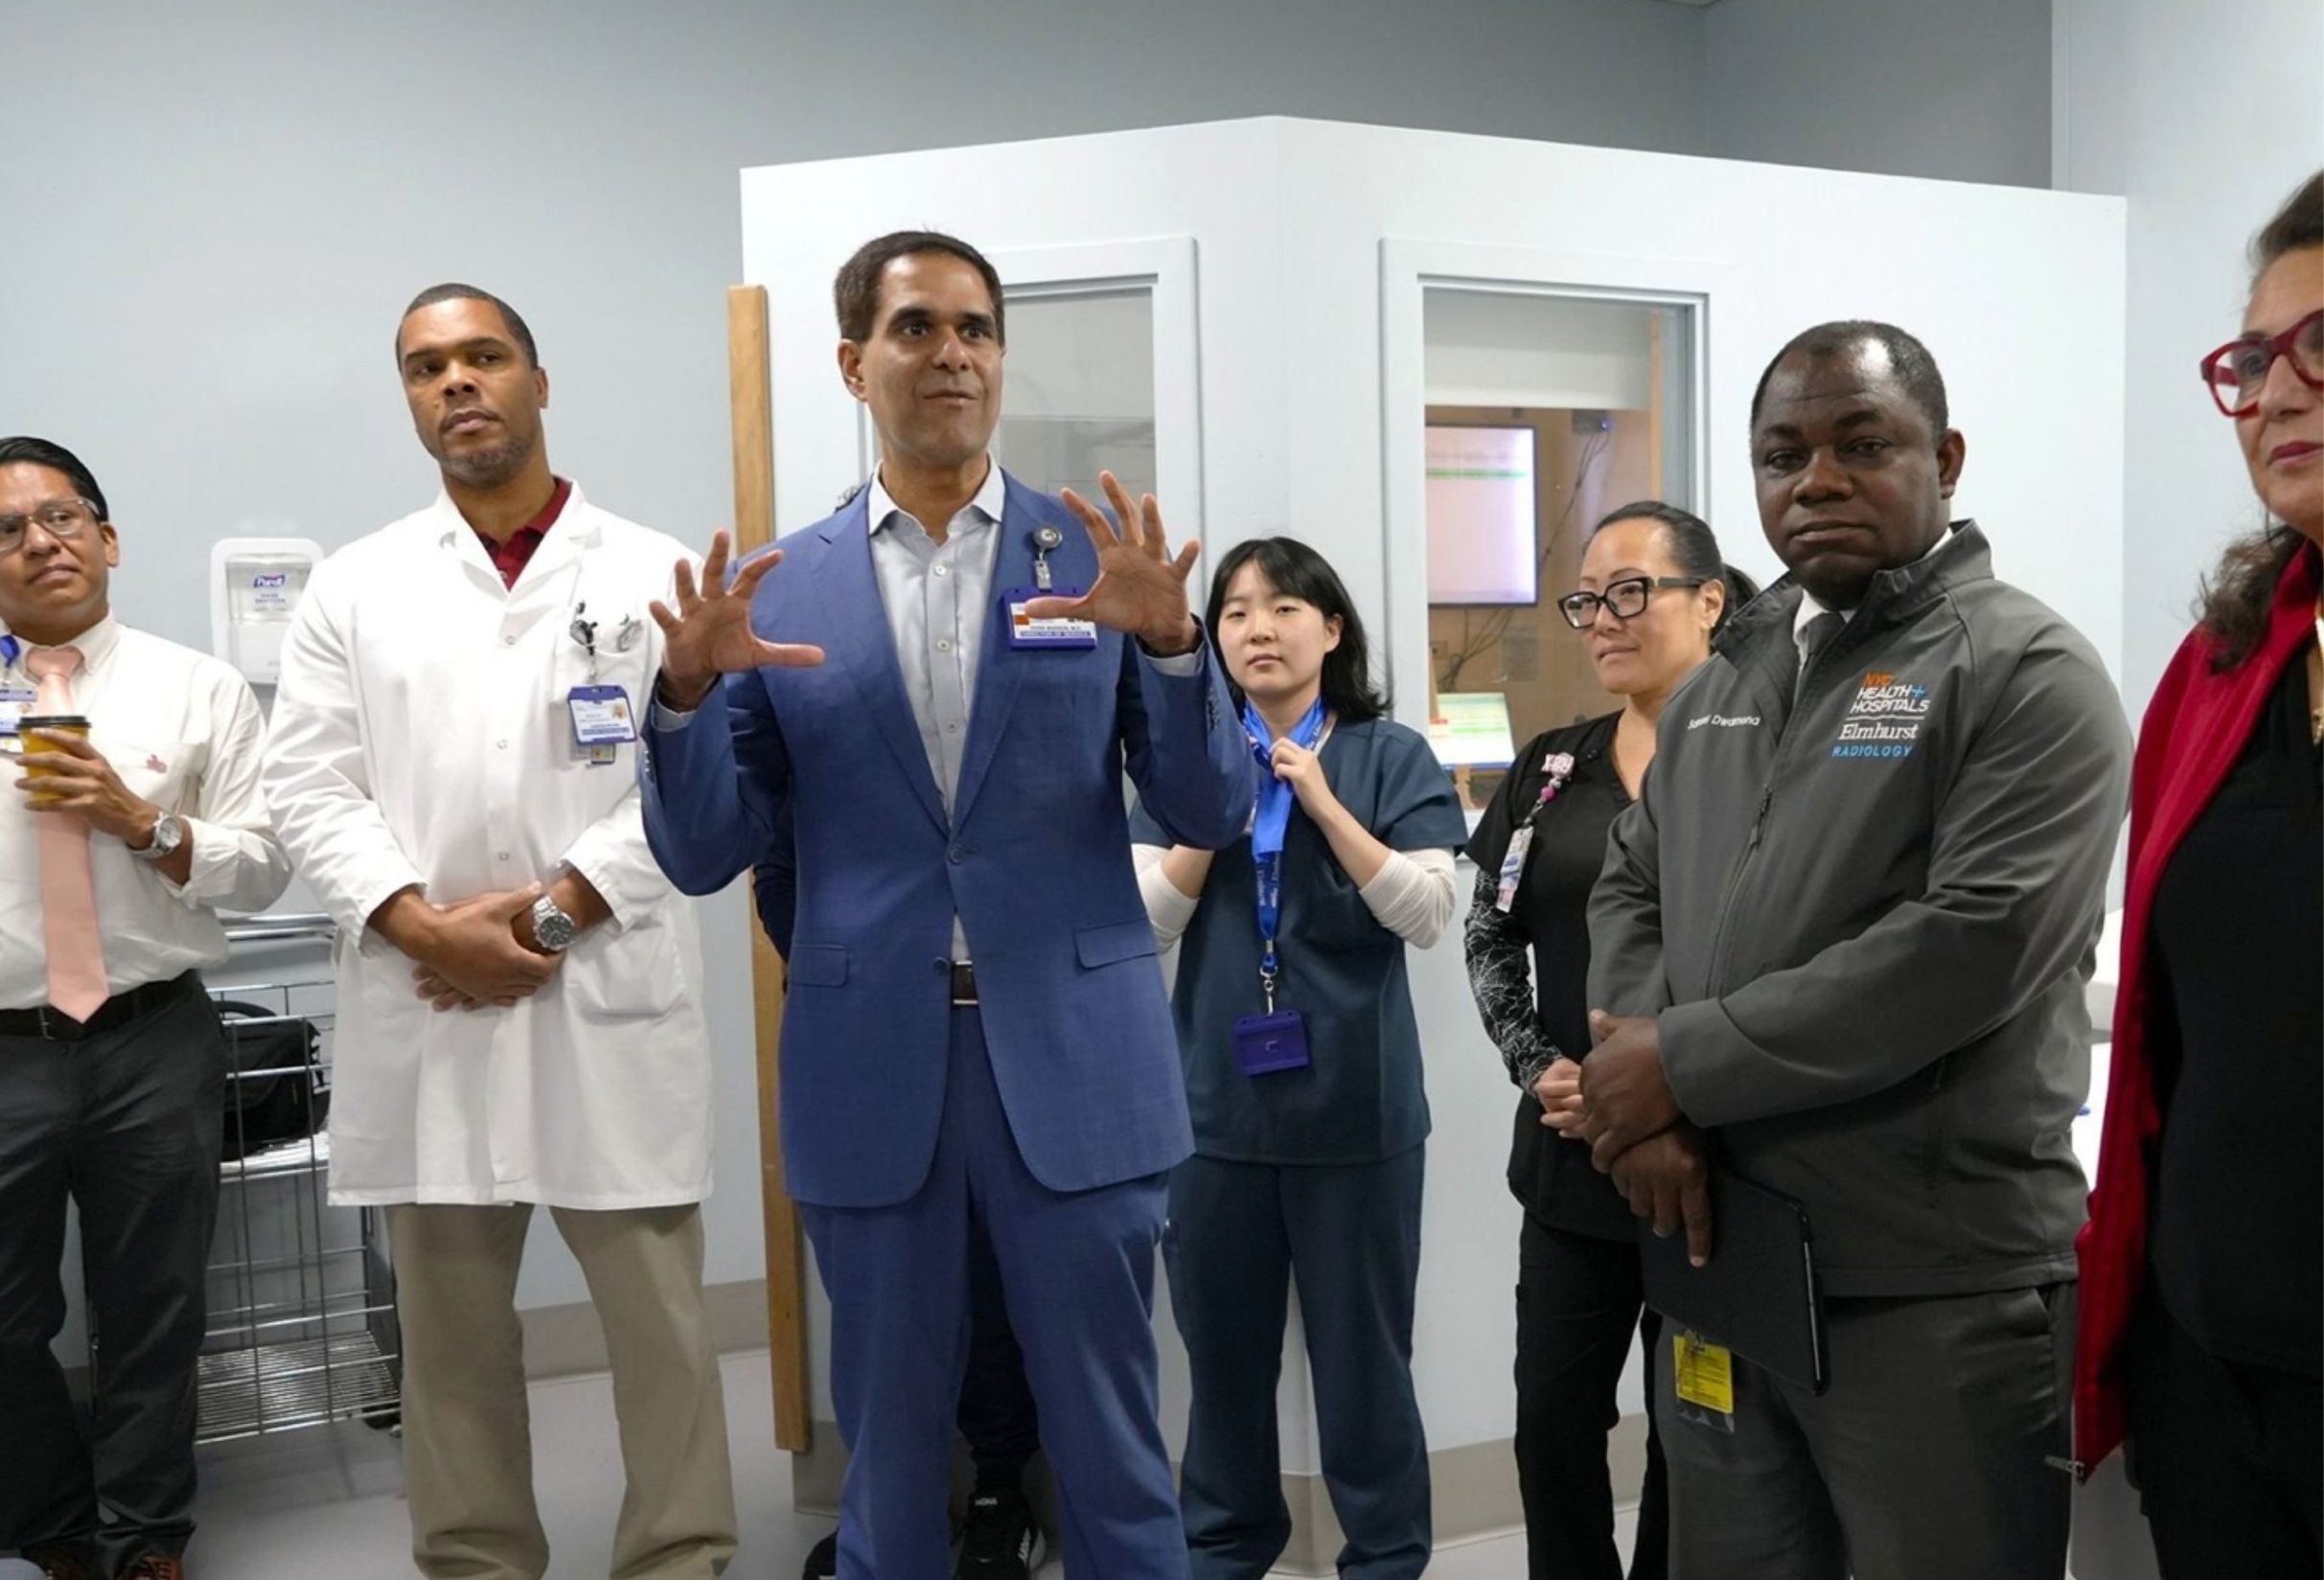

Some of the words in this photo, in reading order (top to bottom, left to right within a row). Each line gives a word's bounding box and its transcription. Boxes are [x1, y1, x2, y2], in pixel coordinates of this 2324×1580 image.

[1863, 673, 1896, 686] NYC
[1850, 698, 1930, 714] HOSPITALS
[1837, 721, 1919, 740] Elmhurst
[1831, 745, 1913, 757] RADIOLOGY
